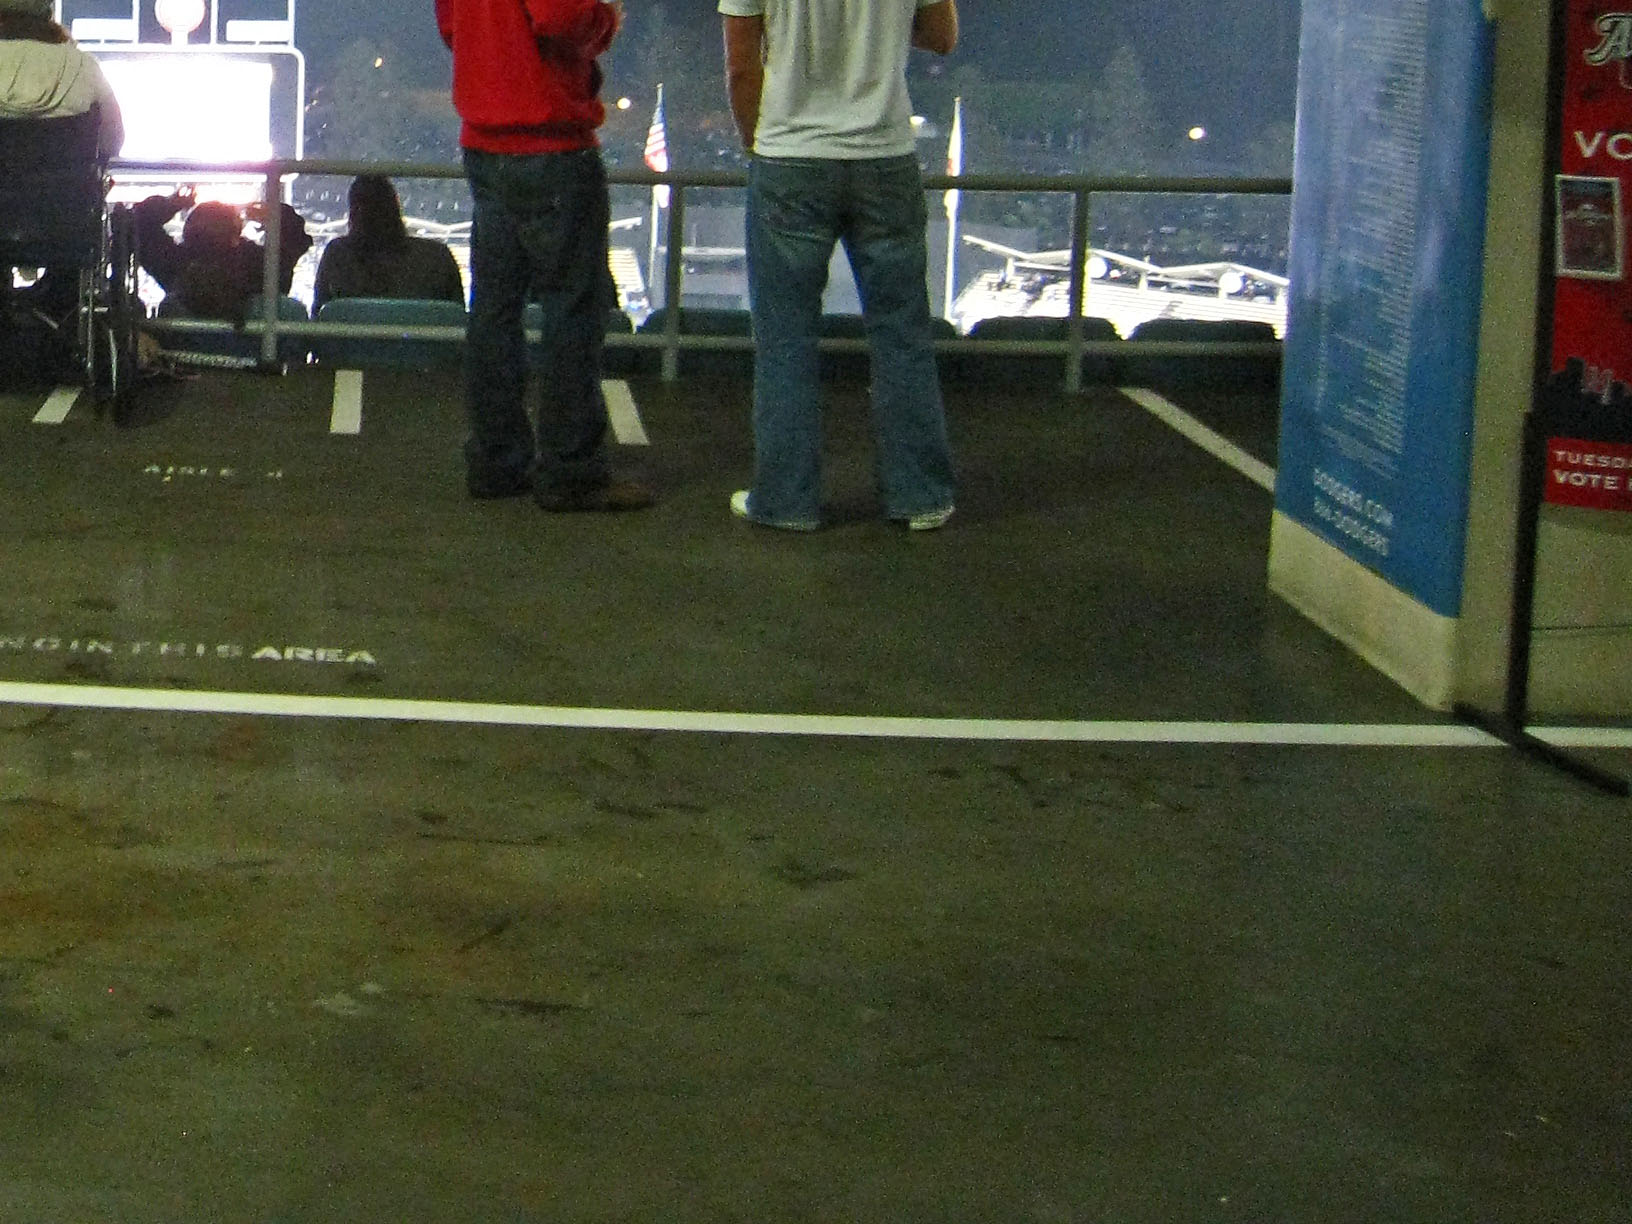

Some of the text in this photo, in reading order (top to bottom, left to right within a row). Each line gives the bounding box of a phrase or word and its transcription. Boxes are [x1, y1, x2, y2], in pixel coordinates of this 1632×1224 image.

[1552, 450, 1632, 469] TUESD
[1552, 469, 1619, 490] VOTE
[251, 645, 376, 665] AREA
